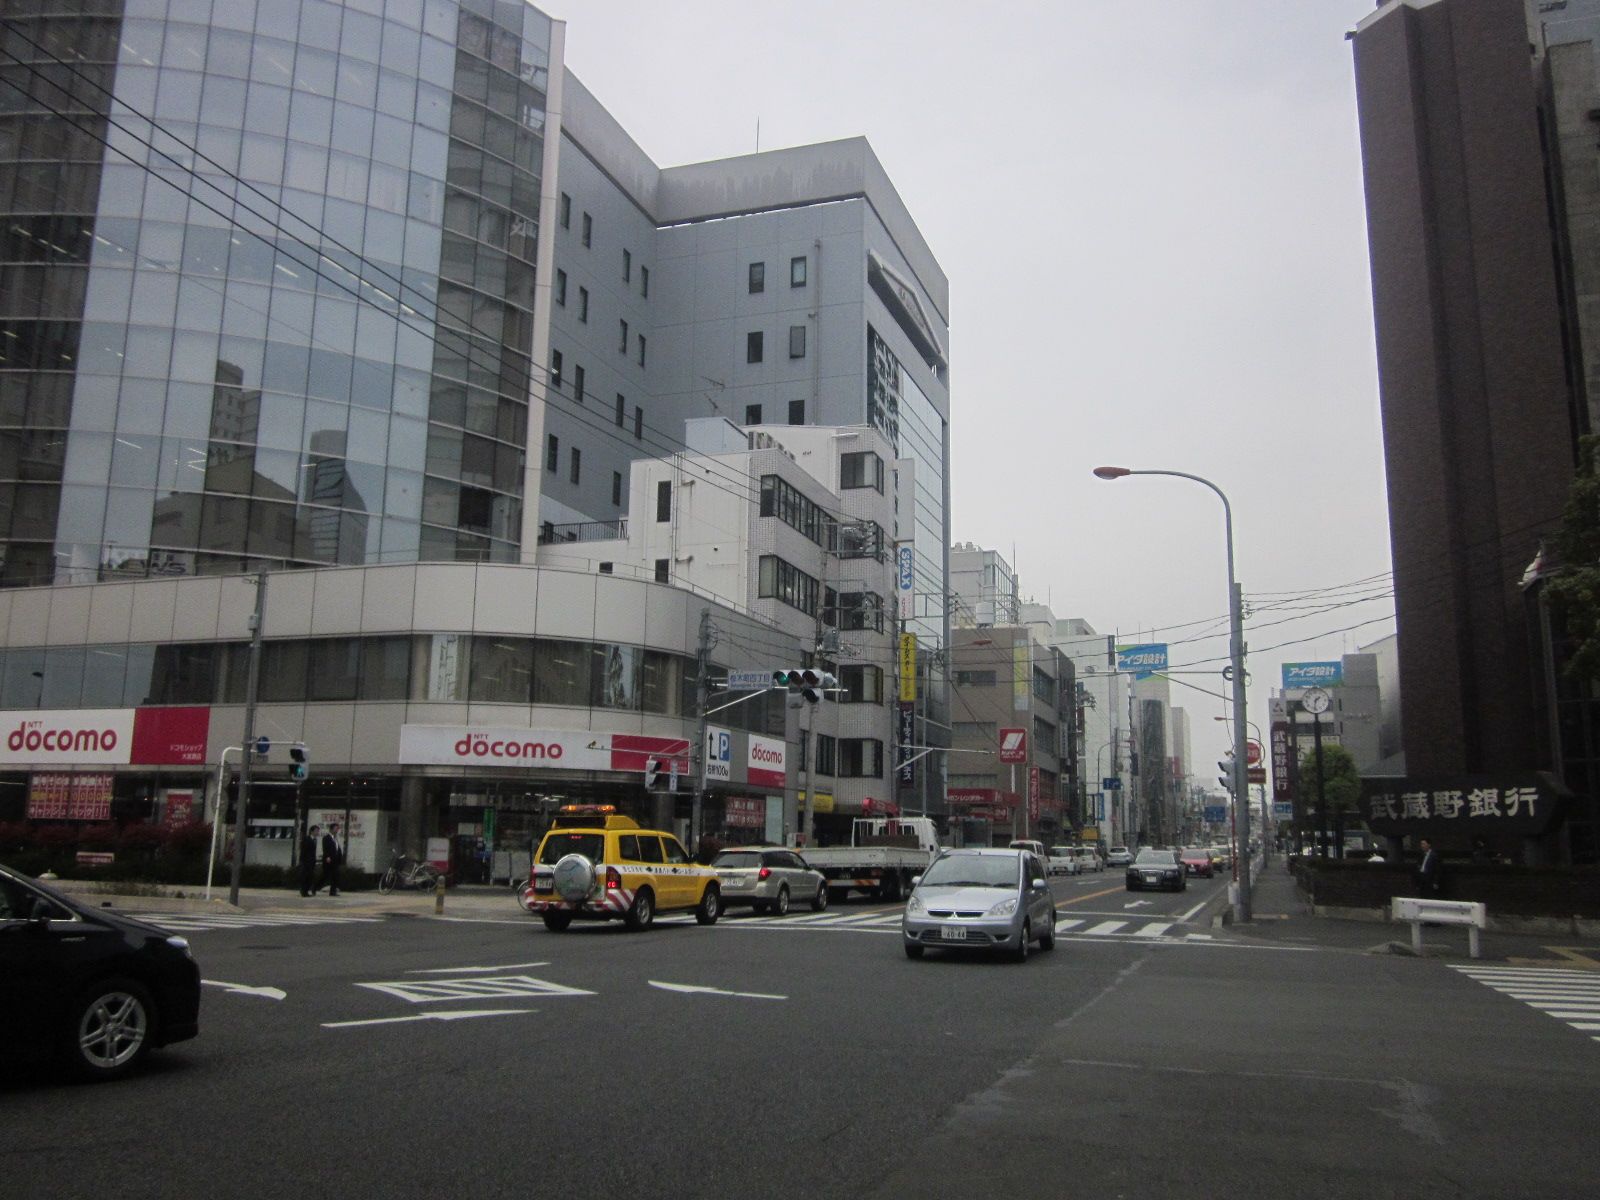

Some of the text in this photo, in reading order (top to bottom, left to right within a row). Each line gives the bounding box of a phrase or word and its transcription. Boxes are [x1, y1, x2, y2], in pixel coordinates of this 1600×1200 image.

[900, 551, 912, 586] SPAX
[8, 721, 117, 751] docomo
[455, 734, 563, 759] docomo
[720, 736, 728, 757] P
[752, 744, 783, 764] docomo
[1274, 731, 1288, 790] 武蔵野銀行
[1371, 787, 1538, 820] 武蔵野銀行
